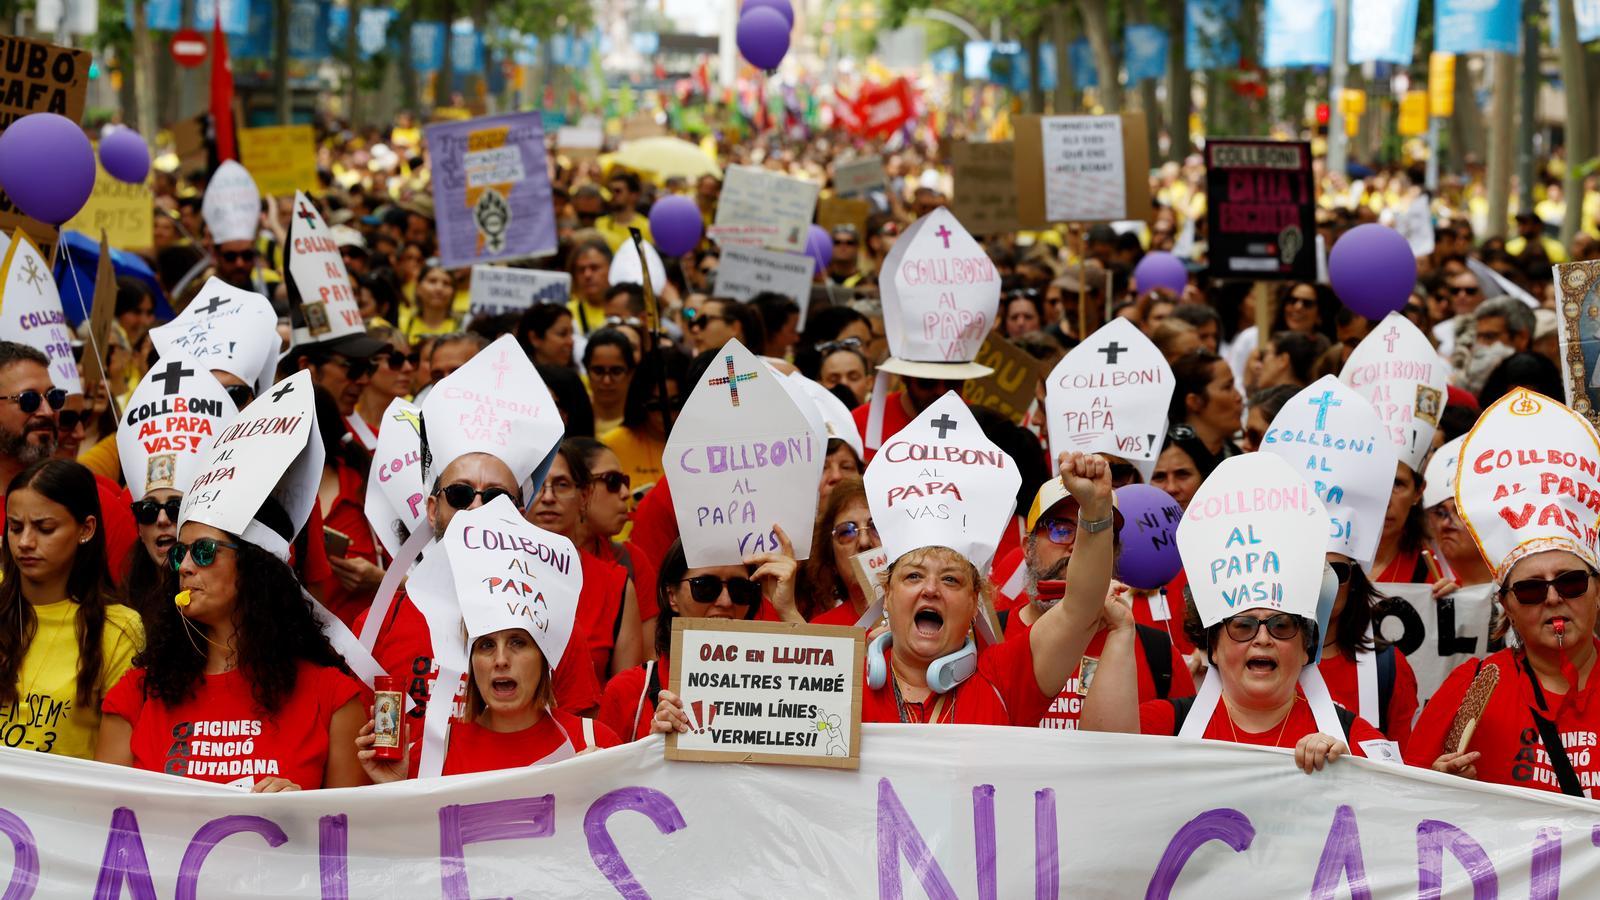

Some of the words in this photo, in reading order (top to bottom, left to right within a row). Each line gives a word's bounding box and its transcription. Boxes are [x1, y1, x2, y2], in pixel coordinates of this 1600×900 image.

[902, 257, 994, 286] COLLBONI
[938, 292, 957, 311] AL
[923, 311, 986, 341] PAPA
[127, 397, 223, 427] COLLBONI
[474, 403, 496, 417] AL
[1091, 396, 1112, 409] AL
[137, 420, 161, 441] AL
[165, 416, 213, 437] PAPA
[459, 413, 513, 434] PAPA
[1063, 411, 1114, 432] PAPA
[143, 436, 202, 455] VAS!
[464, 428, 508, 447] VAS
[212, 449, 235, 465] AL
[1306, 454, 1333, 472] AL
[190, 466, 236, 494] PAPA
[918, 468, 944, 479] AL
[731, 478, 757, 495] AL
[887, 482, 963, 508] PAPA
[1493, 483, 1527, 502] AL
[1539, 472, 1600, 515] PAPA
[697, 500, 756, 527] PAPA
[905, 503, 950, 520] VAS
[1225, 525, 1262, 548] AL
[508, 558, 537, 579] AL
[1210, 551, 1281, 584] PAPA
[481, 576, 548, 610] PAPA
[1221, 581, 1284, 609] VAS!!
[699, 643, 739, 663] OAC
[772, 646, 835, 667] LLUITA
[688, 672, 782, 690] NOSALTRES
[788, 673, 845, 693] TAMBÉ
[713, 701, 763, 717] TENIM
[767, 698, 818, 719] LÍNIES
[172, 719, 262, 740] OFICINES
[711, 729, 818, 747] VERMELLES!!
[166, 737, 255, 757] ATENCIÓ
[165, 759, 280, 777] CIUTADANA
